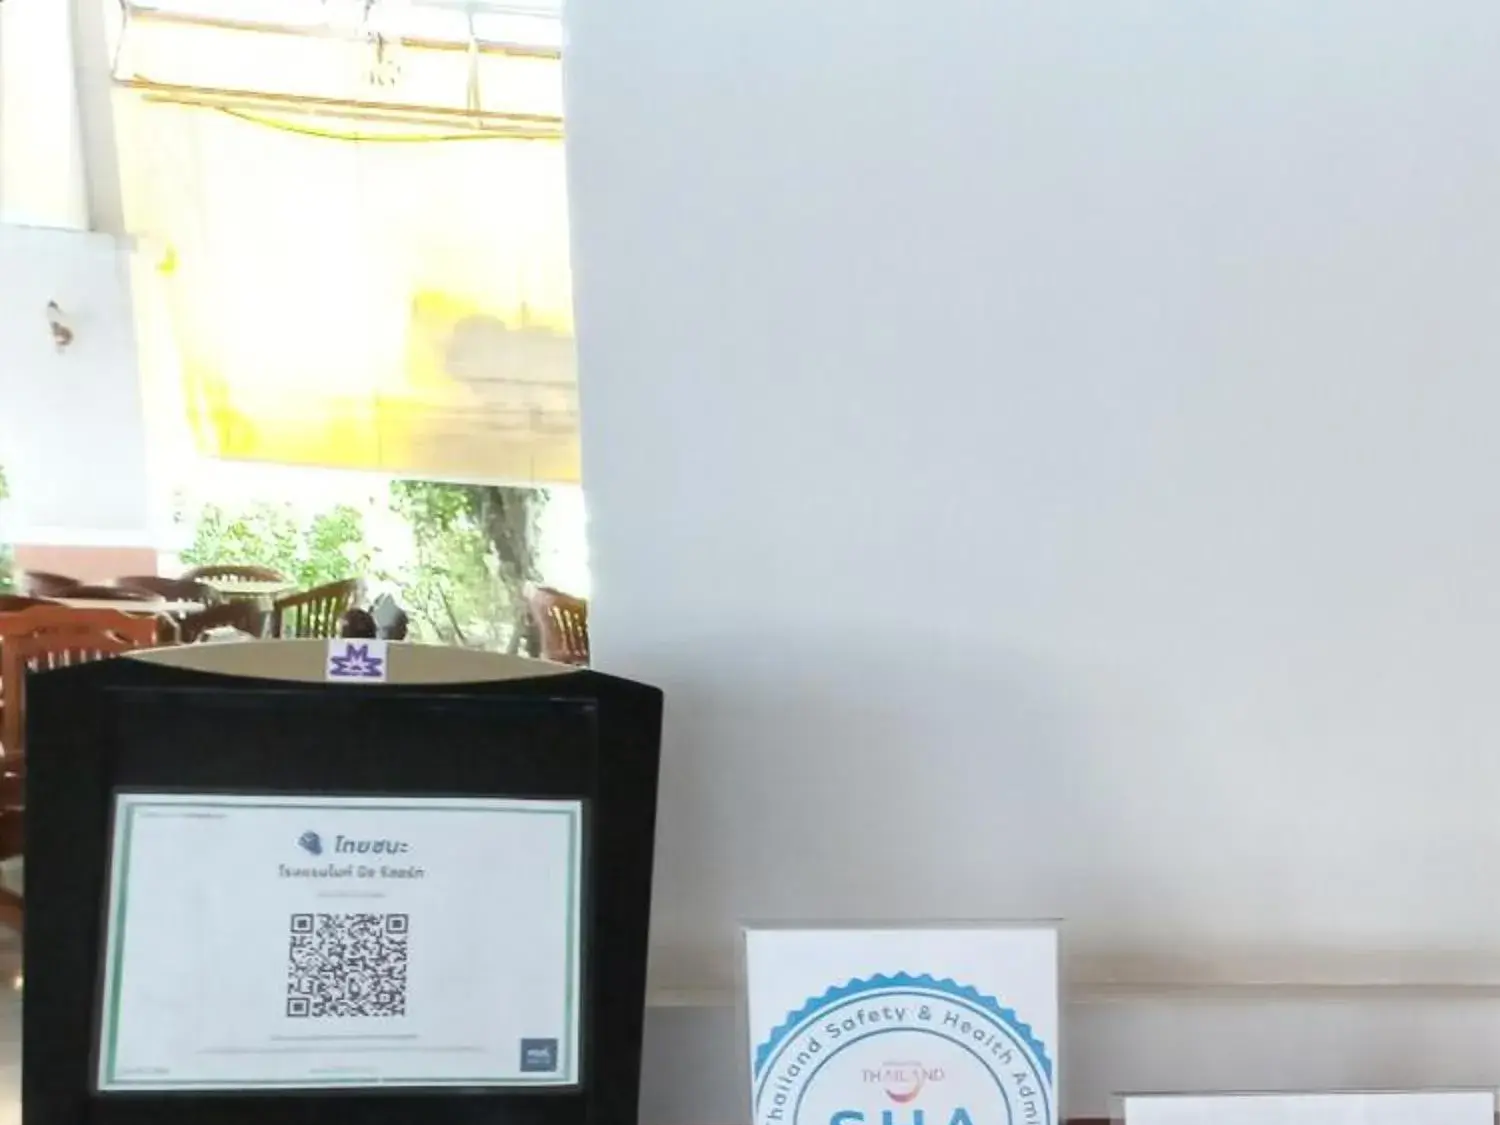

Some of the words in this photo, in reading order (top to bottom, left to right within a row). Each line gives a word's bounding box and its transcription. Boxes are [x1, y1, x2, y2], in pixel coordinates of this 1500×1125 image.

[825, 1005, 907, 1040] Safety
[917, 1005, 932, 1021] &
[943, 1010, 1013, 1068] Health
